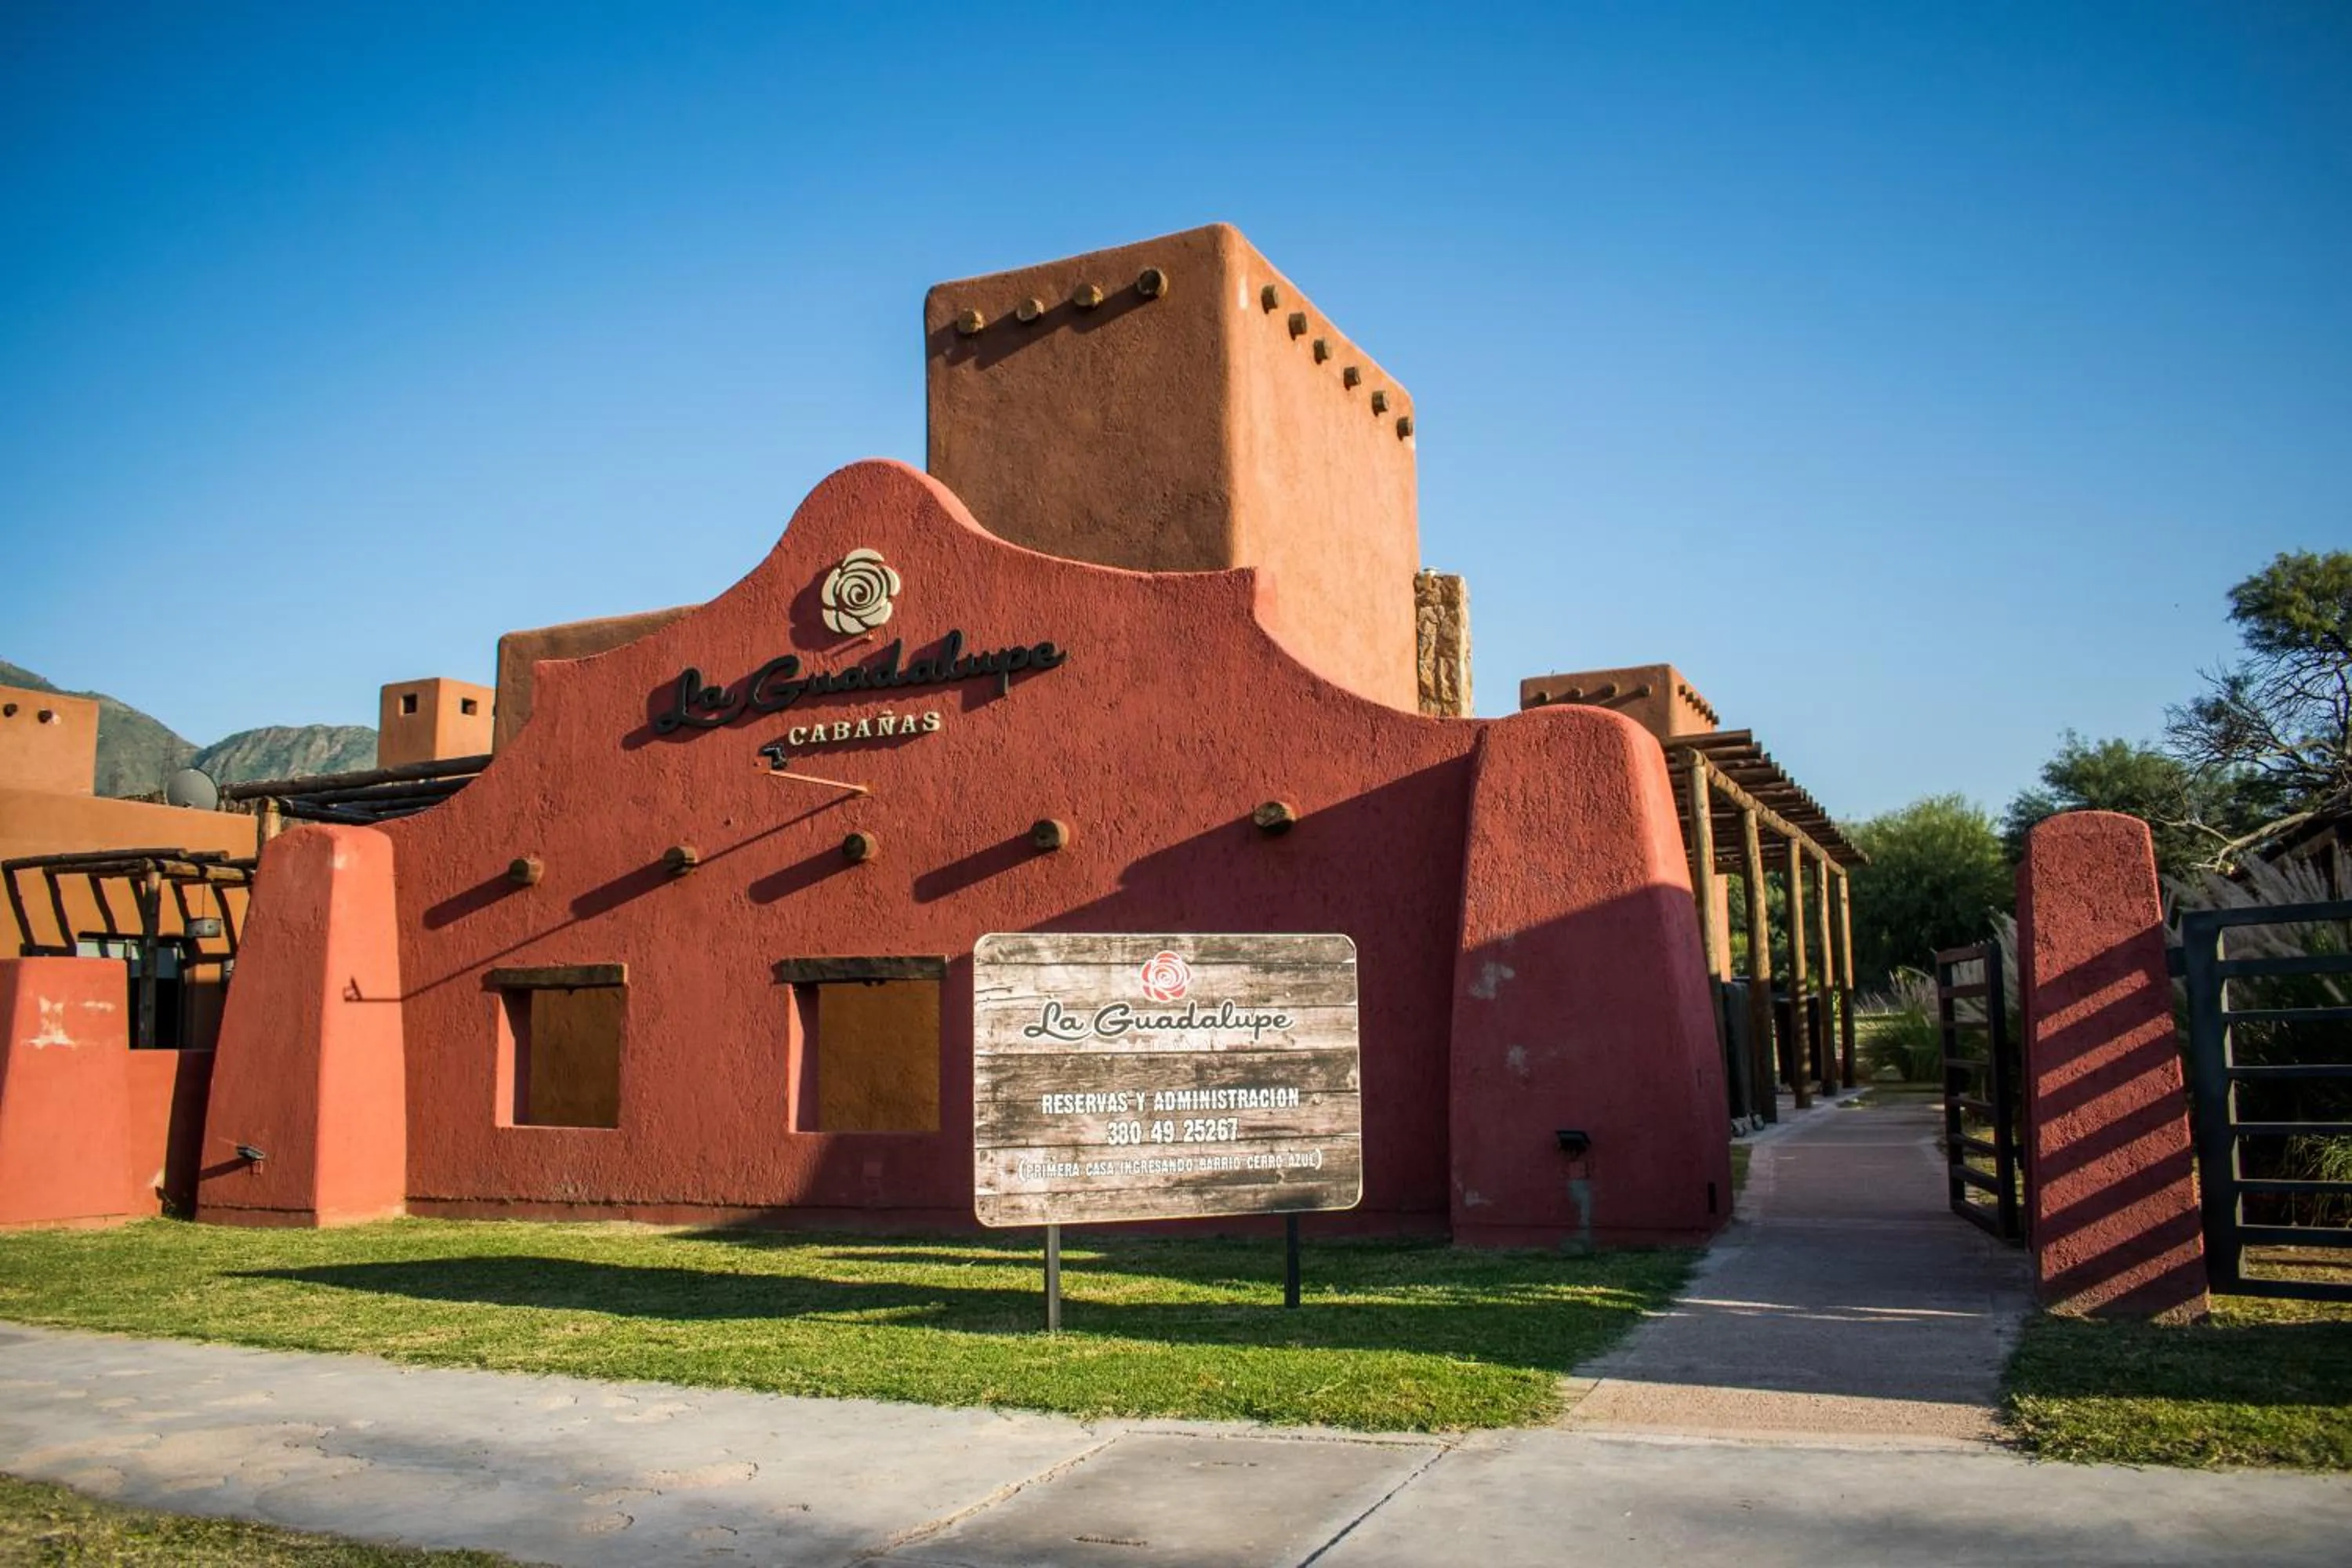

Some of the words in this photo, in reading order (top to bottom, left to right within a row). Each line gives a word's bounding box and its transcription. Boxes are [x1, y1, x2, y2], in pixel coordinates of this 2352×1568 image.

[652, 666, 744, 735] La
[746, 629, 1067, 712] Guadalupe
[789, 710, 941, 746] CABAÑAS
[1023, 1000, 1091, 1040] La
[1094, 1001, 1294, 1039] Guadalupe
[1042, 1092, 1128, 1114] RESERVAS
[1135, 1091, 1145, 1111] Y
[1154, 1087, 1299, 1111] ADMINISTRACION
[1107, 1121, 1142, 1145] 380
[1150, 1120, 1174, 1143] 49
[1183, 1117, 1238, 1142] 25267
[1018, 1156, 1080, 1181] (PRIMERA
[1086, 1160, 1114, 1176] CASA
[1120, 1158, 1192, 1174] INGRESANDO
[1200, 1156, 1240, 1171] BARRIO
[1247, 1155, 1282, 1169] CERRO
